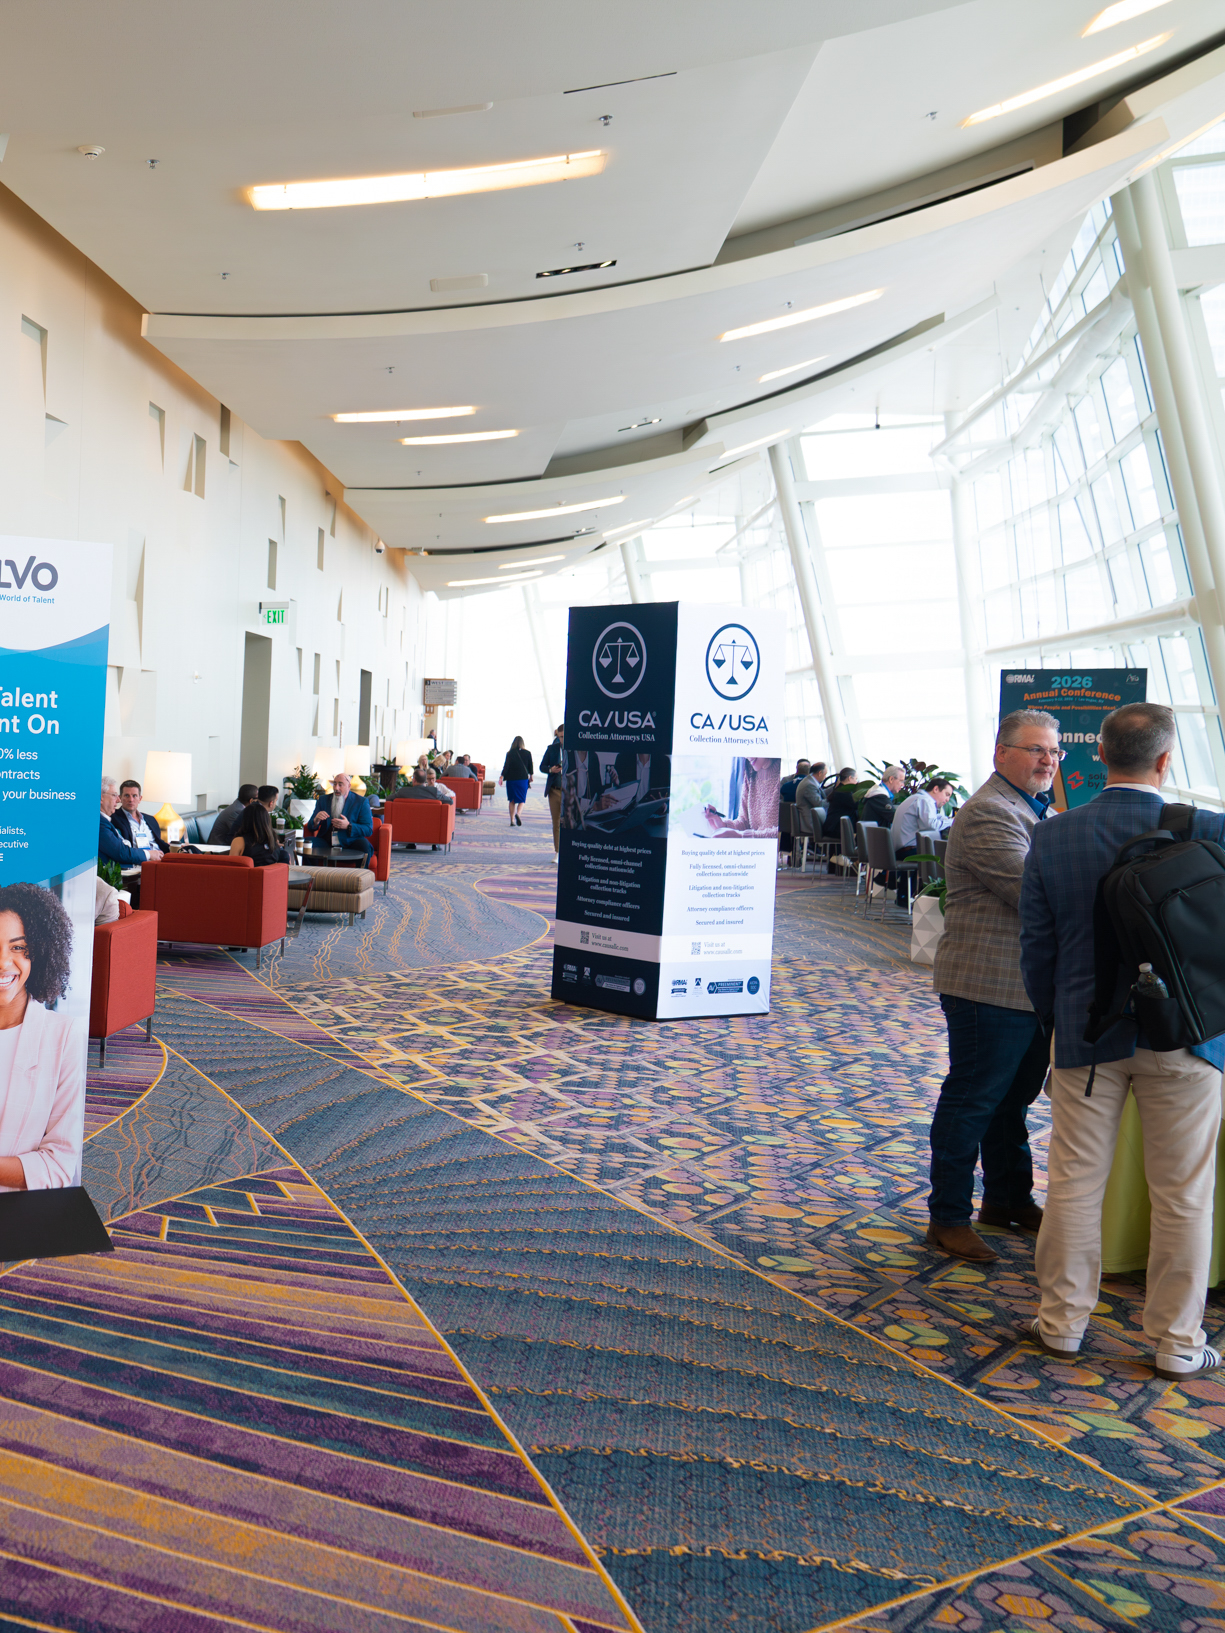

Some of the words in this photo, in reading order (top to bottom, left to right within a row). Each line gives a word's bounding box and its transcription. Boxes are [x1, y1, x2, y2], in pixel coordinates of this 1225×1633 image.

[0, 593, 22, 602] World
[22, 595, 31, 603] of
[32, 596, 55, 605] Talent
[267, 609, 285, 624] EXIT
[1051, 676, 1093, 689] 2026
[1023, 688, 1059, 702] Annual
[1060, 688, 1121, 702] Conference
[27, 714, 60, 735] On
[578, 731, 609, 741] Collection
[609, 732, 641, 743] Attorneys
[641, 734, 656, 742] USA
[689, 735, 722, 745] Collection
[722, 736, 755, 747] Attorneys
[755, 737, 769, 745] USA
[16, 749, 39, 761] less
[2, 790, 27, 802] your
[29, 789, 77, 800] business
[708, 905, 735, 913] compliance
